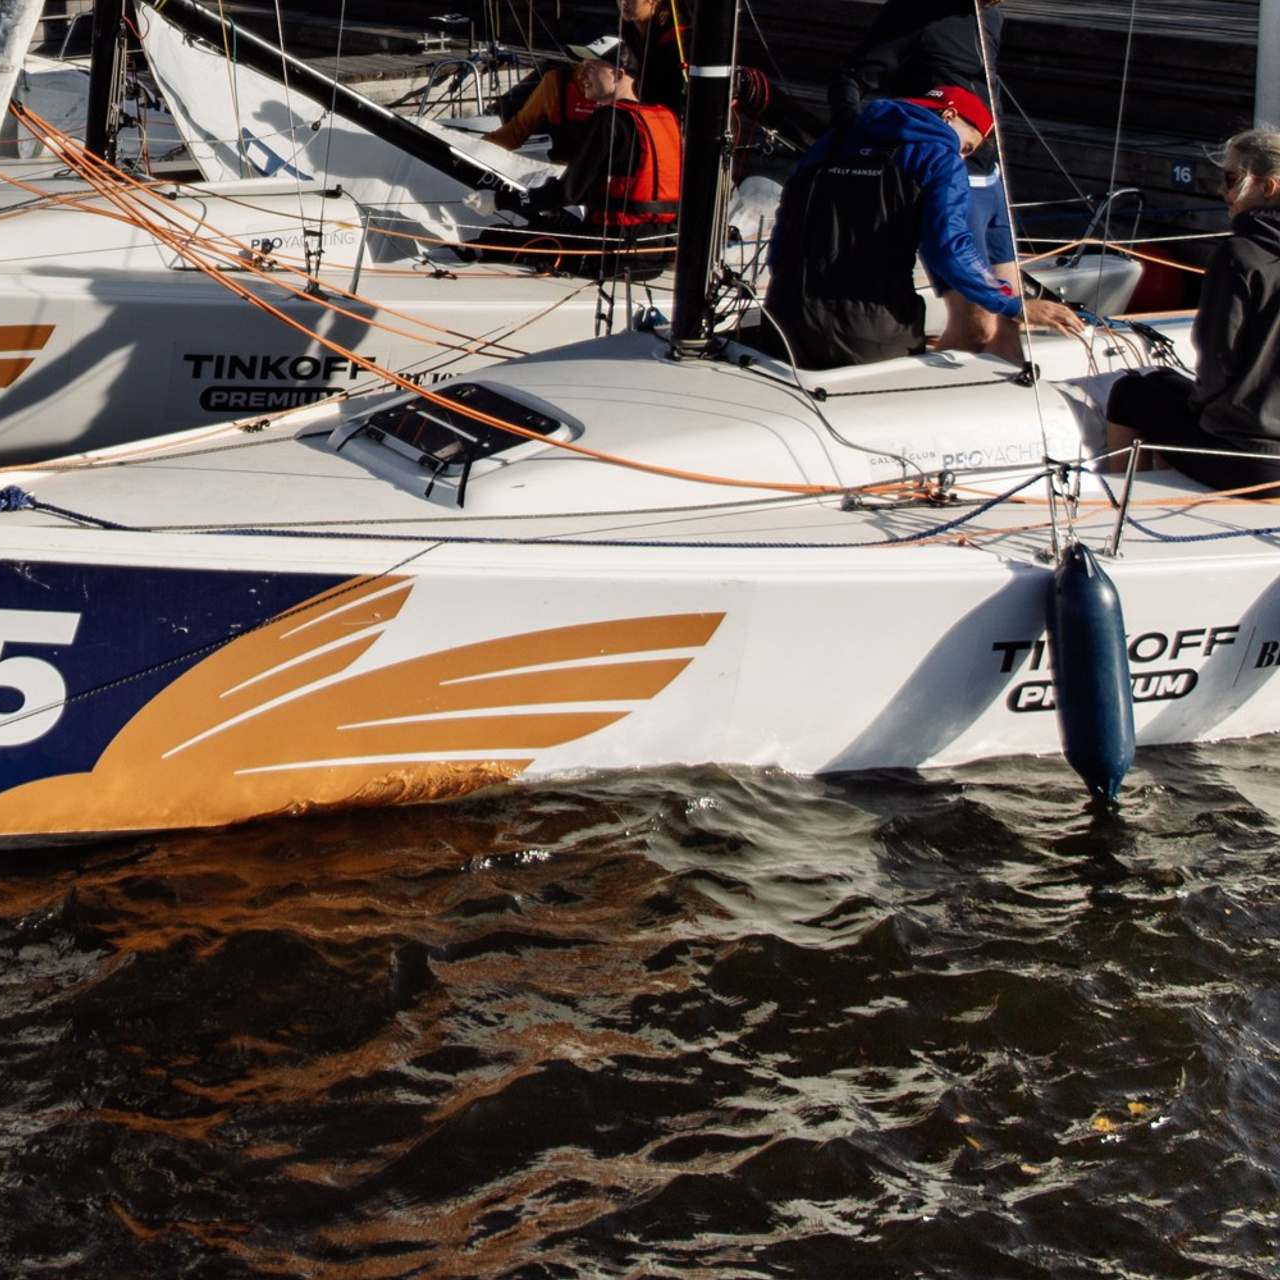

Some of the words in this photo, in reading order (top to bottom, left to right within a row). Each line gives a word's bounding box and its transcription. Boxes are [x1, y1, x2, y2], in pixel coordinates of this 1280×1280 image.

[1173, 166, 1192, 183] 16
[183, 353, 376, 381] TINKOFF
[991, 624, 1241, 673] TIOFF
